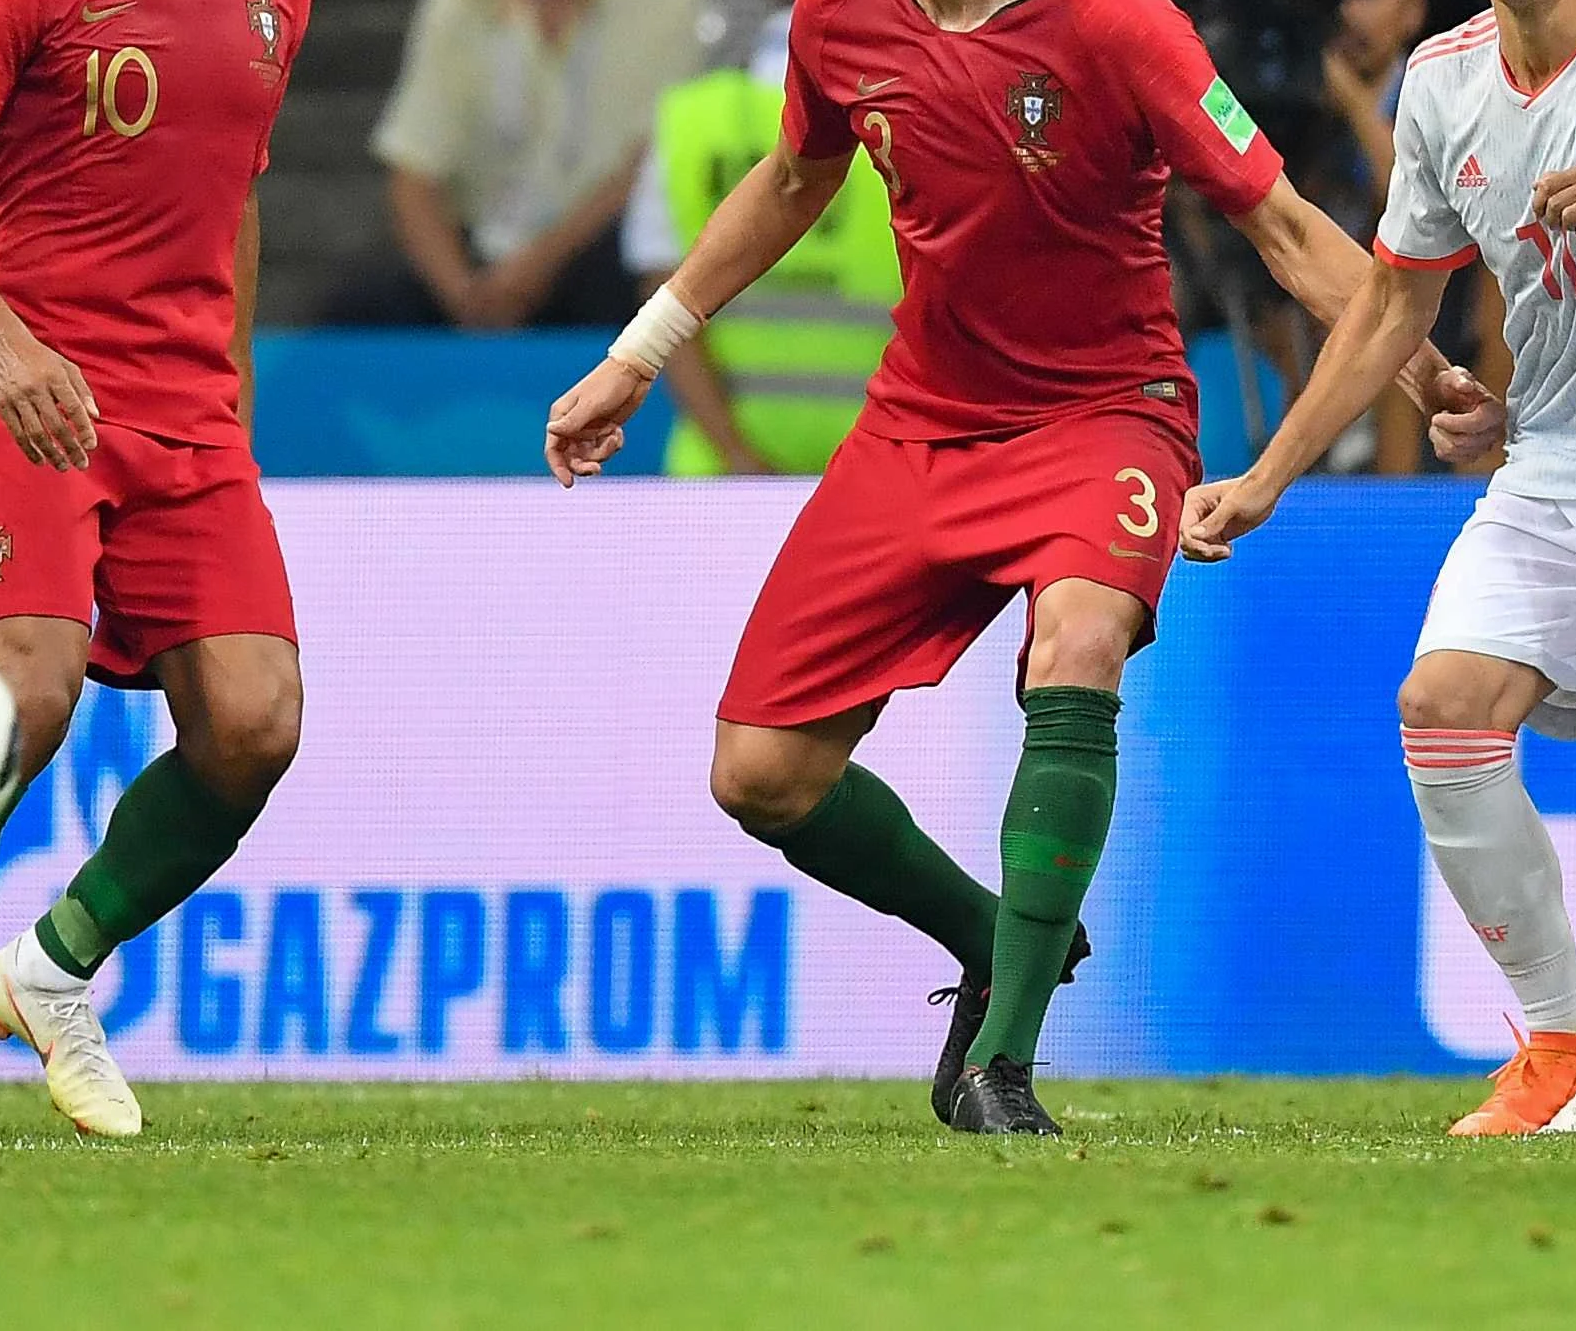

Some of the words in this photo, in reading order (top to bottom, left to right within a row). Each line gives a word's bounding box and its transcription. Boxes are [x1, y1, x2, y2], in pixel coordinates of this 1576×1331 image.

[82, 45, 158, 138] 10
[863, 110, 901, 197] 3
[1113, 466, 1160, 538] 3
[179, 887, 791, 1055] GAZPROM
